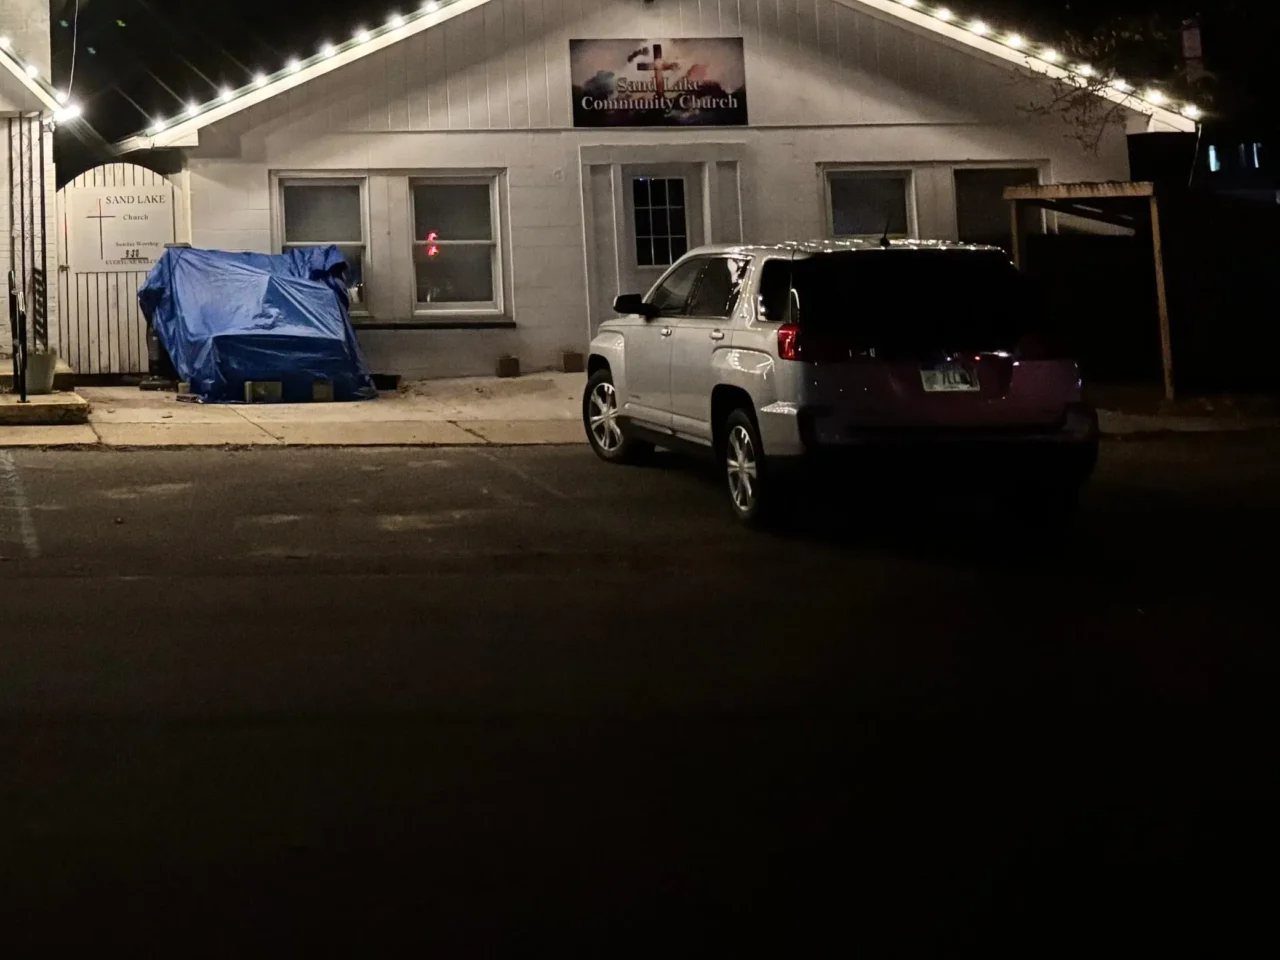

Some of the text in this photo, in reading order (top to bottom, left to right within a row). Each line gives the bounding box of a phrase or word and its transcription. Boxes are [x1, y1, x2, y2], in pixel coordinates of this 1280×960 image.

[581, 95, 738, 113] Community Church
[106, 194, 166, 204] SAND LAKE
